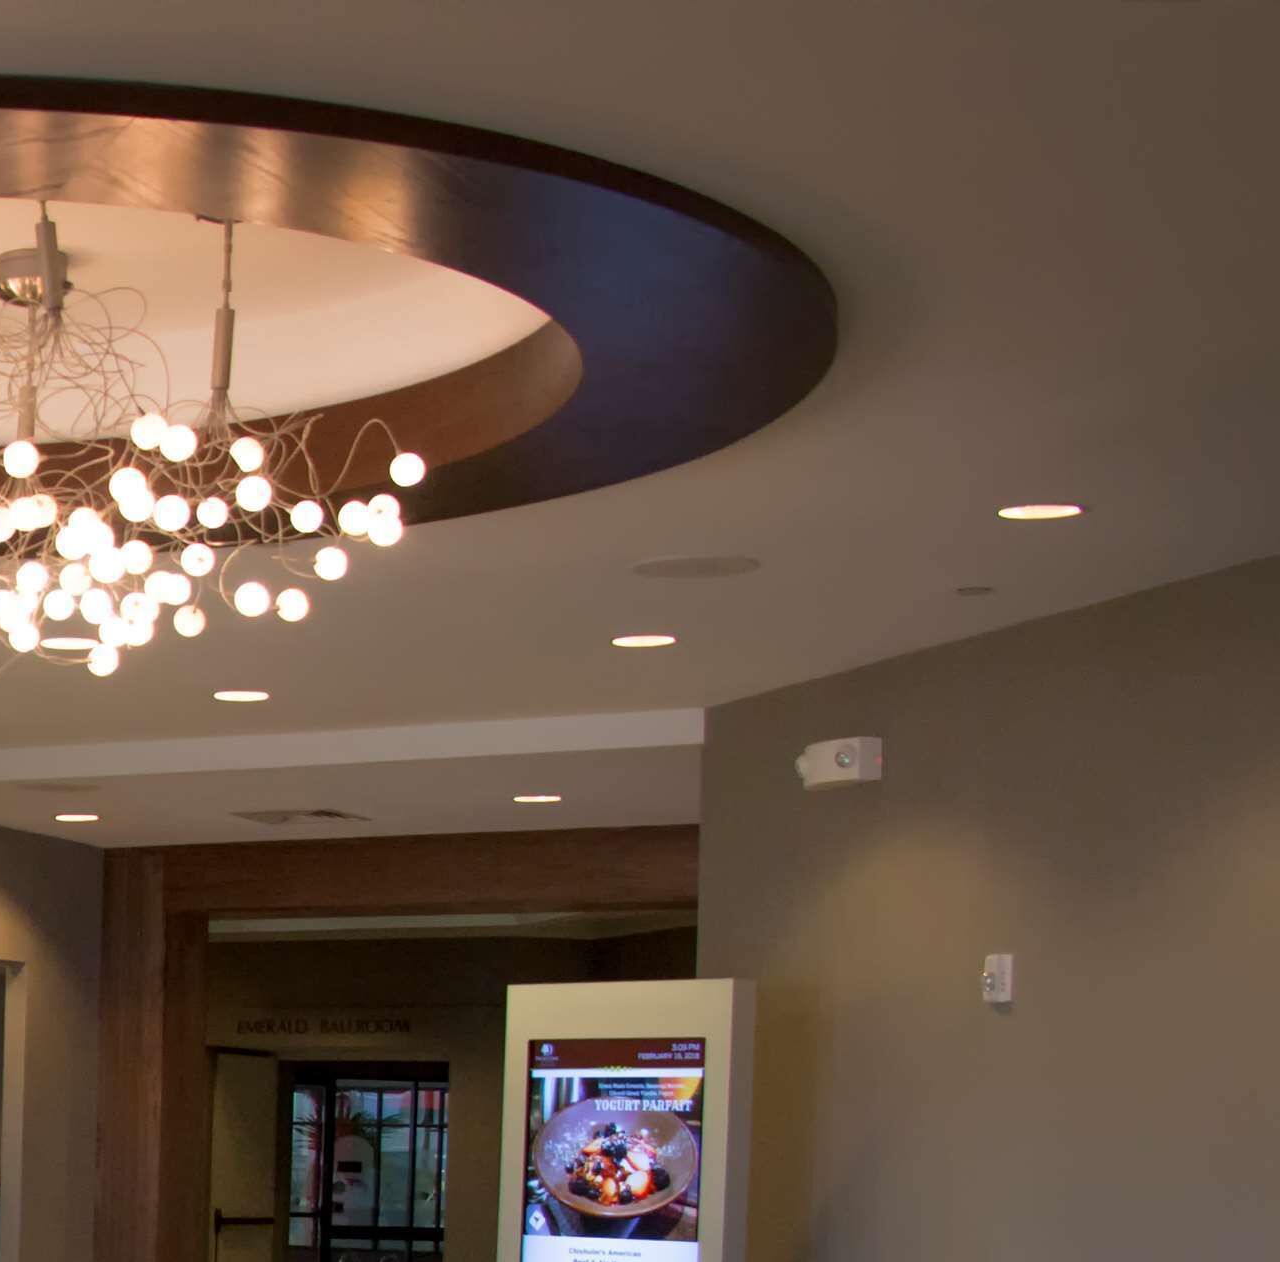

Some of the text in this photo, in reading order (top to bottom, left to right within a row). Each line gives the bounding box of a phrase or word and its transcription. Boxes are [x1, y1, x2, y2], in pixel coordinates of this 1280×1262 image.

[237, 1019, 411, 1035] EMERALD BALLROOM
[637, 1052, 673, 1060] FEBRUARY
[594, 1099, 693, 1112] YOGURT PARFAIT
[608, 1249, 642, 1257] American
